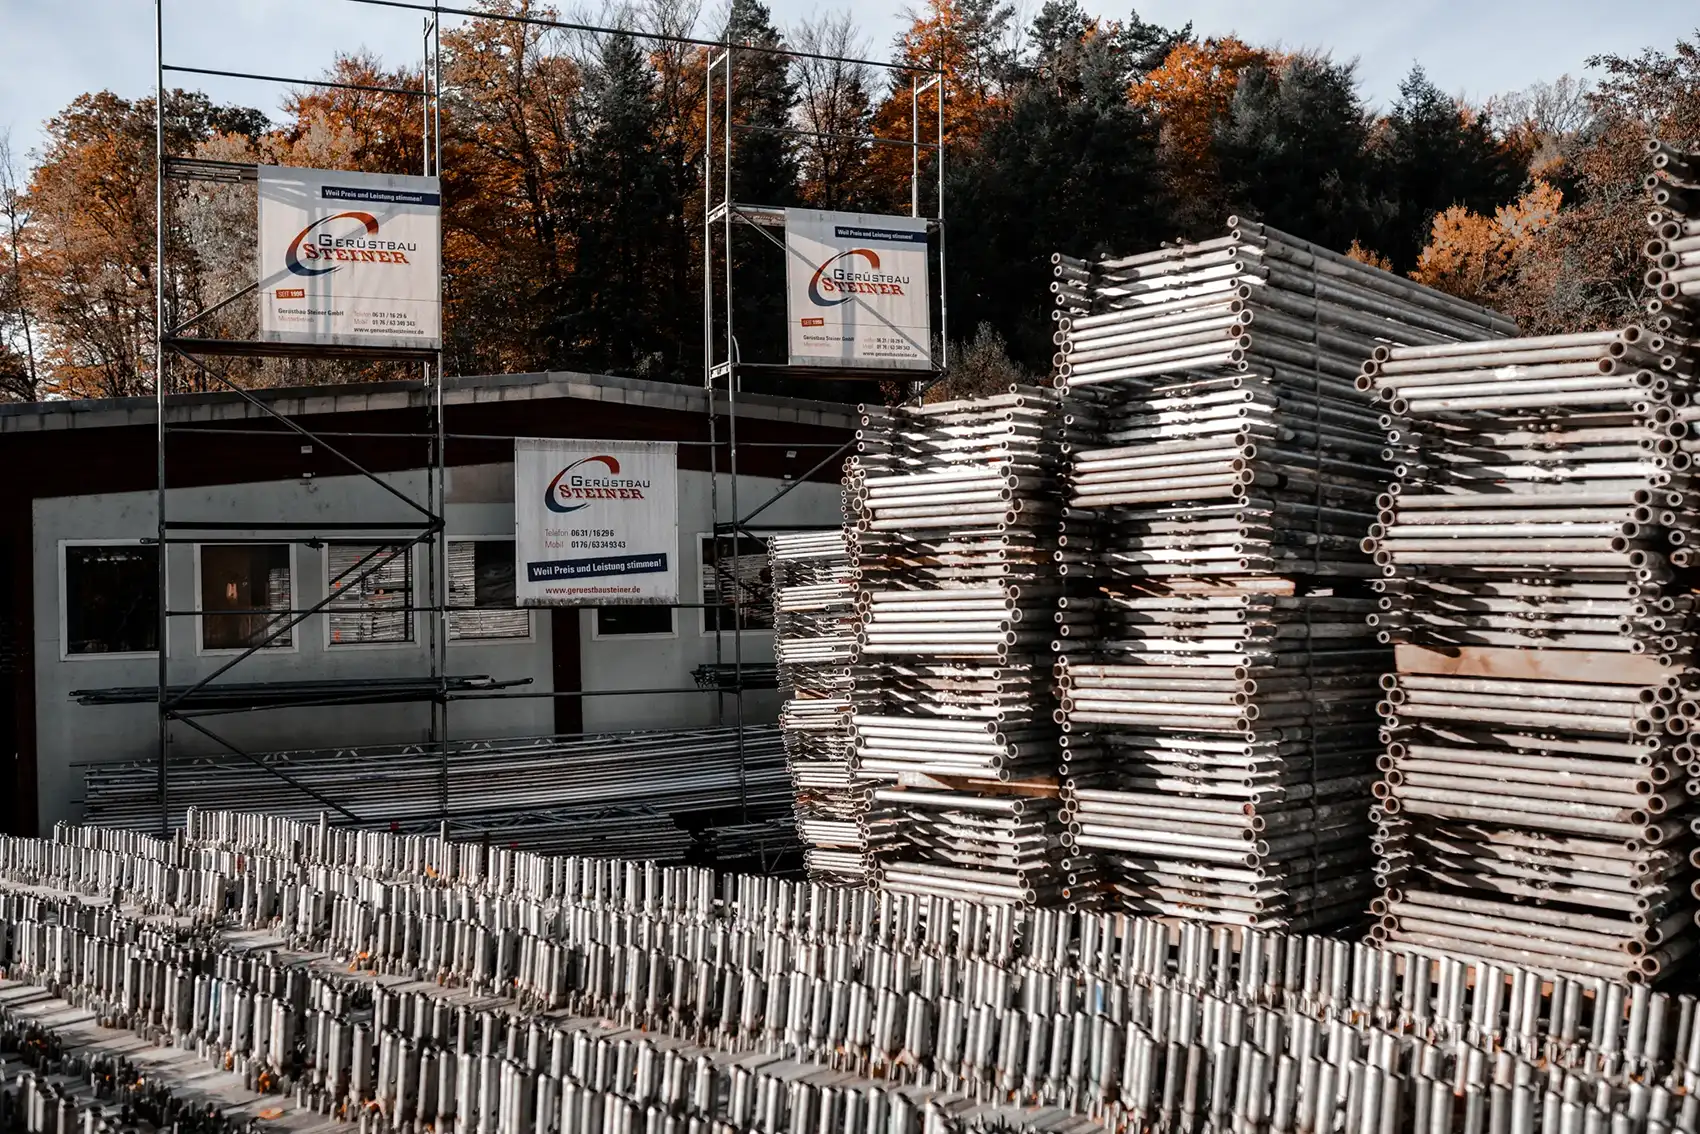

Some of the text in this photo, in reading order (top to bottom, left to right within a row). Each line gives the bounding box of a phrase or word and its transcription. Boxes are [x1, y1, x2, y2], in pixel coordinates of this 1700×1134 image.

[325, 189, 339, 197] Weil
[341, 190, 356, 198] Preis
[370, 192, 394, 201] Leistung
[395, 194, 422, 202] stimmen!
[319, 233, 416, 251] GERÜSTBAU
[303, 243, 410, 264] STEINER
[834, 268, 910, 284] GERÜSTBAU
[821, 277, 904, 295] STEINER
[307, 308, 326, 316] Steiner
[571, 475, 650, 488] GERÜSTBAU
[558, 484, 645, 499] STEINER
[545, 528, 568, 537] Telefon
[545, 541, 563, 549] Mobil
[533, 559, 662, 576] Weil Preis und Leistung stimmen!
[545, 585, 641, 595] www.geruestbausteiner.de
